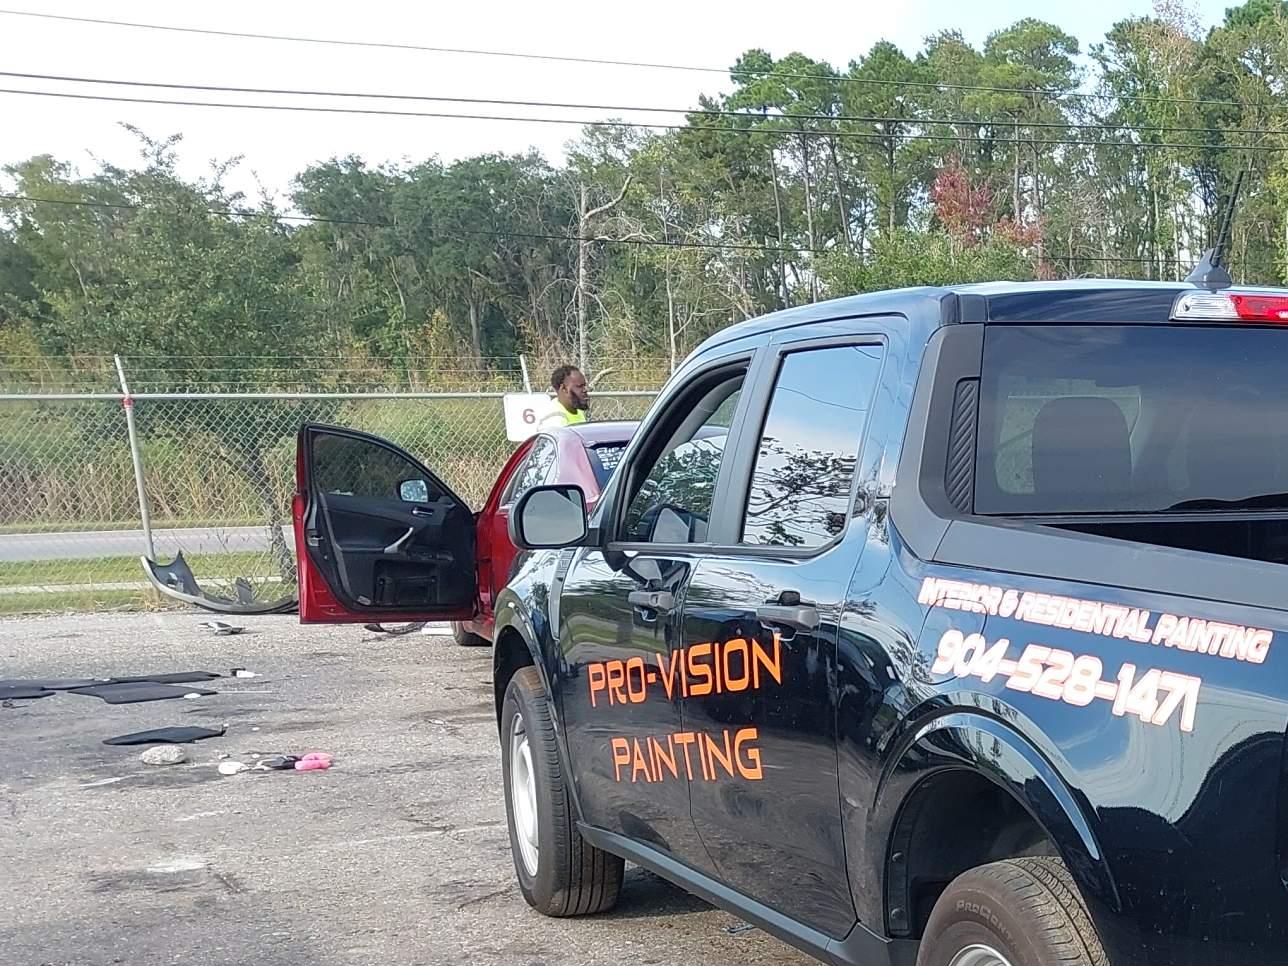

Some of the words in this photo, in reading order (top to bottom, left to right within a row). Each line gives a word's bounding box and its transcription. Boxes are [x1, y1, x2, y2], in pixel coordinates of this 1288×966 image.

[522, 408, 536, 424] 6
[1014, 591, 1151, 643] RESIDENTIAL
[1151, 613, 1274, 664] PAINTING
[588, 632, 782, 708] PRO-VISION
[931, 628, 1202, 733] 904-528-1471
[610, 727, 763, 782] PAINTING
